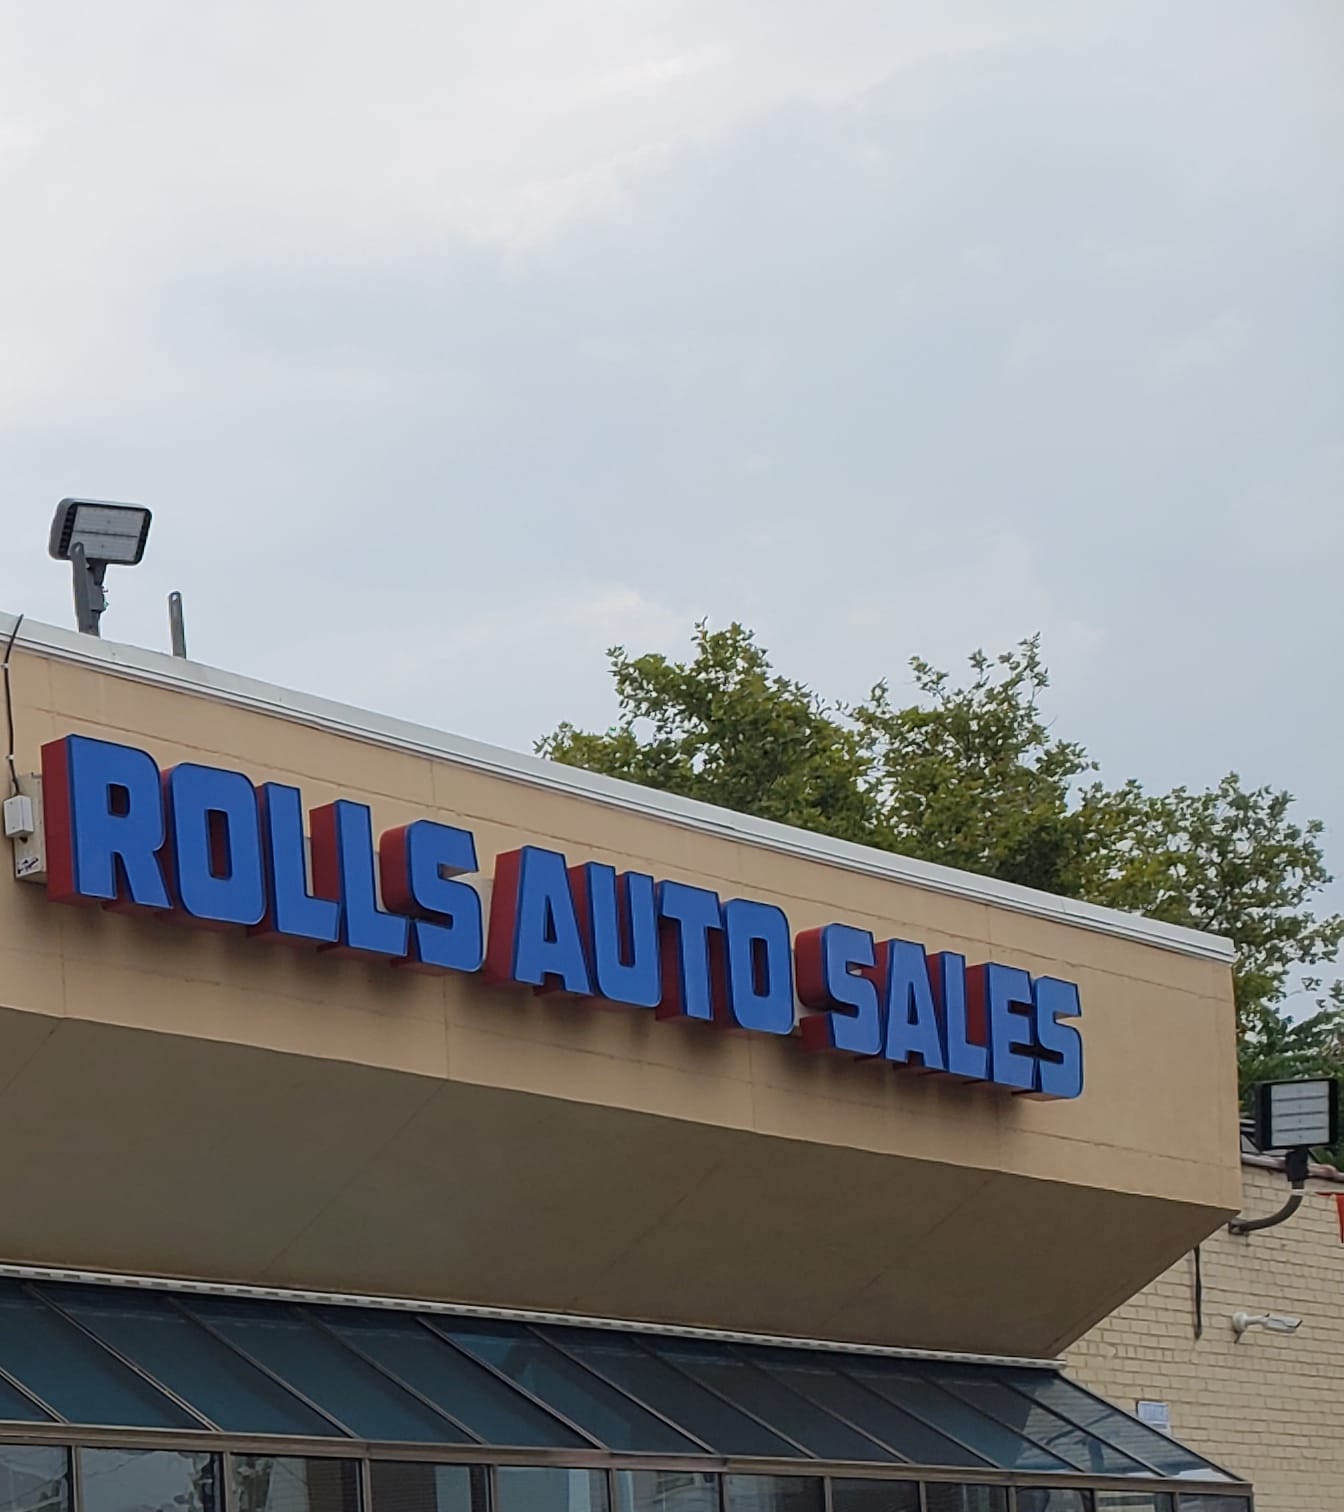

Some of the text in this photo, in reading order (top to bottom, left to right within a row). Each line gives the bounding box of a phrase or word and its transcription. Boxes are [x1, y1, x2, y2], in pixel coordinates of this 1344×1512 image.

[46, 735, 1084, 1098] ROLLS AUTO SALES
